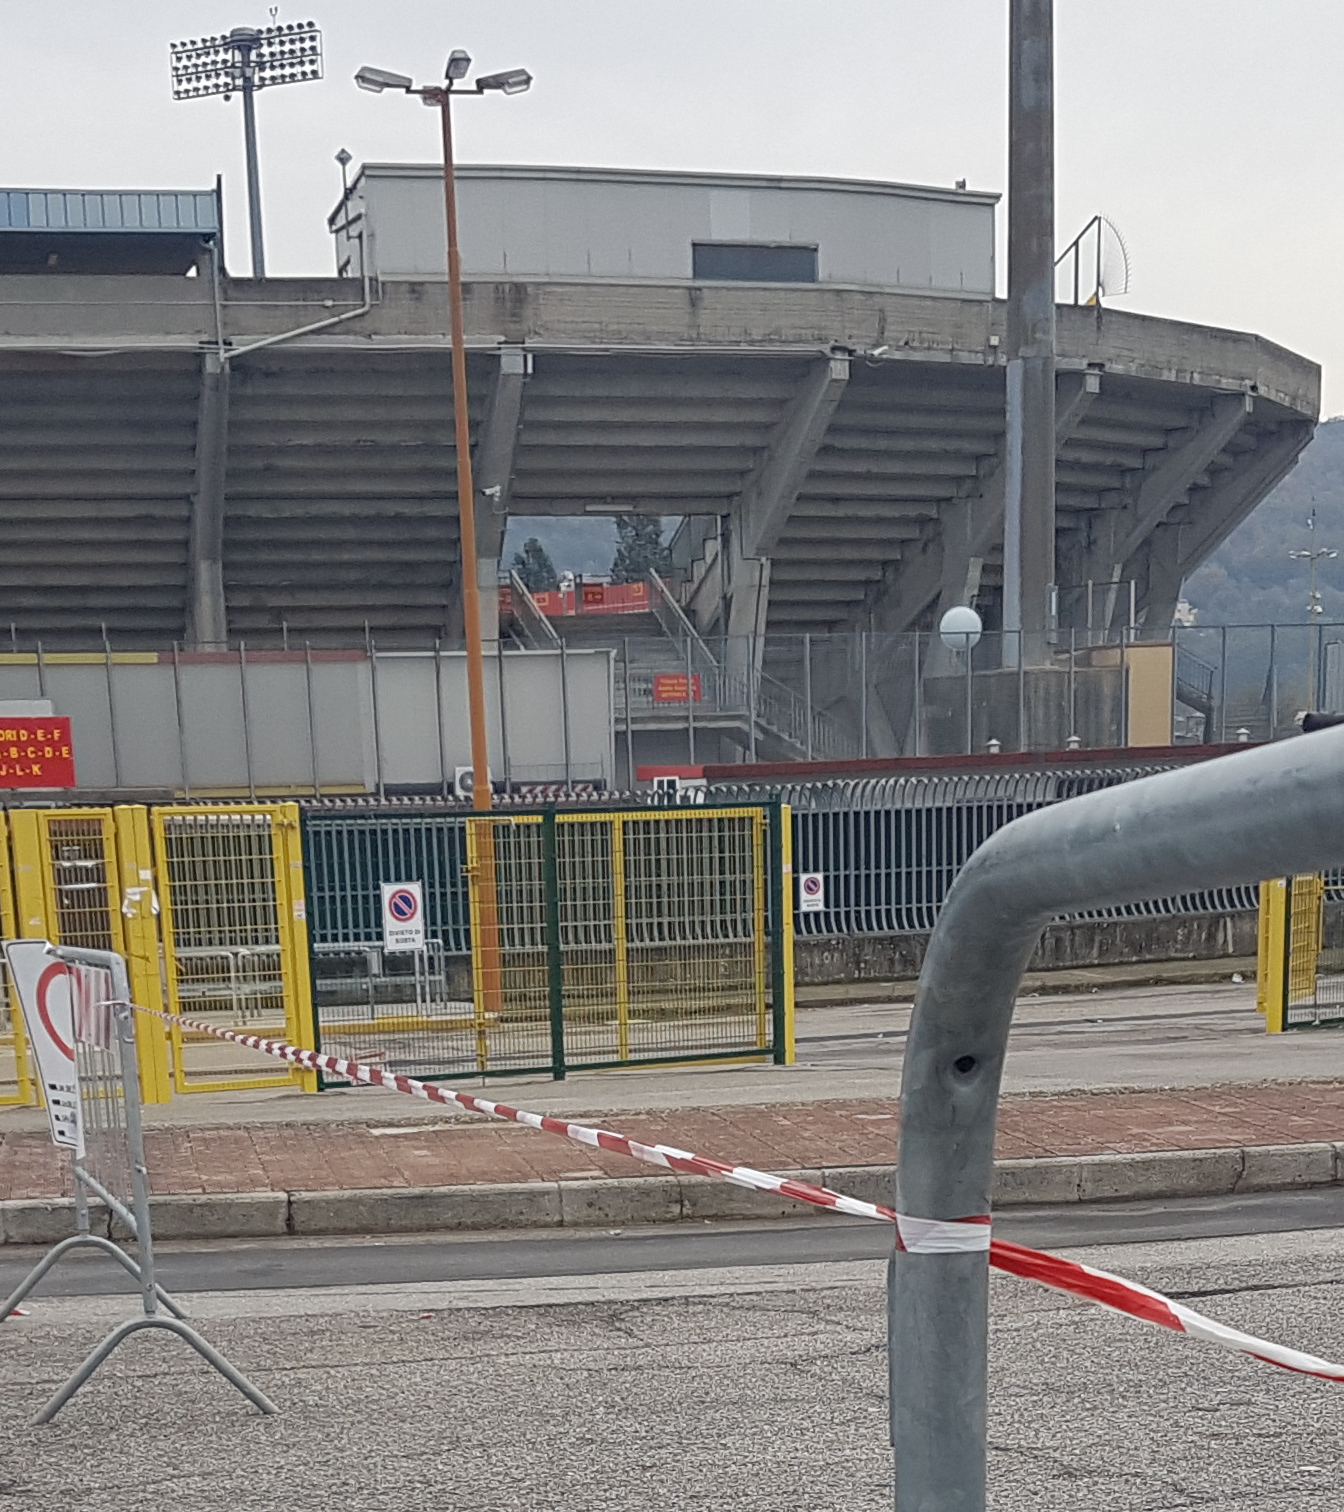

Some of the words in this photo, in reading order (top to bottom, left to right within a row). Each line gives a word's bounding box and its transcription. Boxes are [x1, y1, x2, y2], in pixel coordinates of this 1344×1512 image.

[19, 729, 28, 741] D
[37, 729, 45, 741] E
[53, 729, 61, 740] F
[9, 747, 18, 758] B
[27, 746, 36, 758] C
[44, 746, 53, 758] D
[61, 746, 70, 758] E
[0, 764, 7, 776] J
[16, 764, 24, 775] L
[31, 763, 42, 775] K
